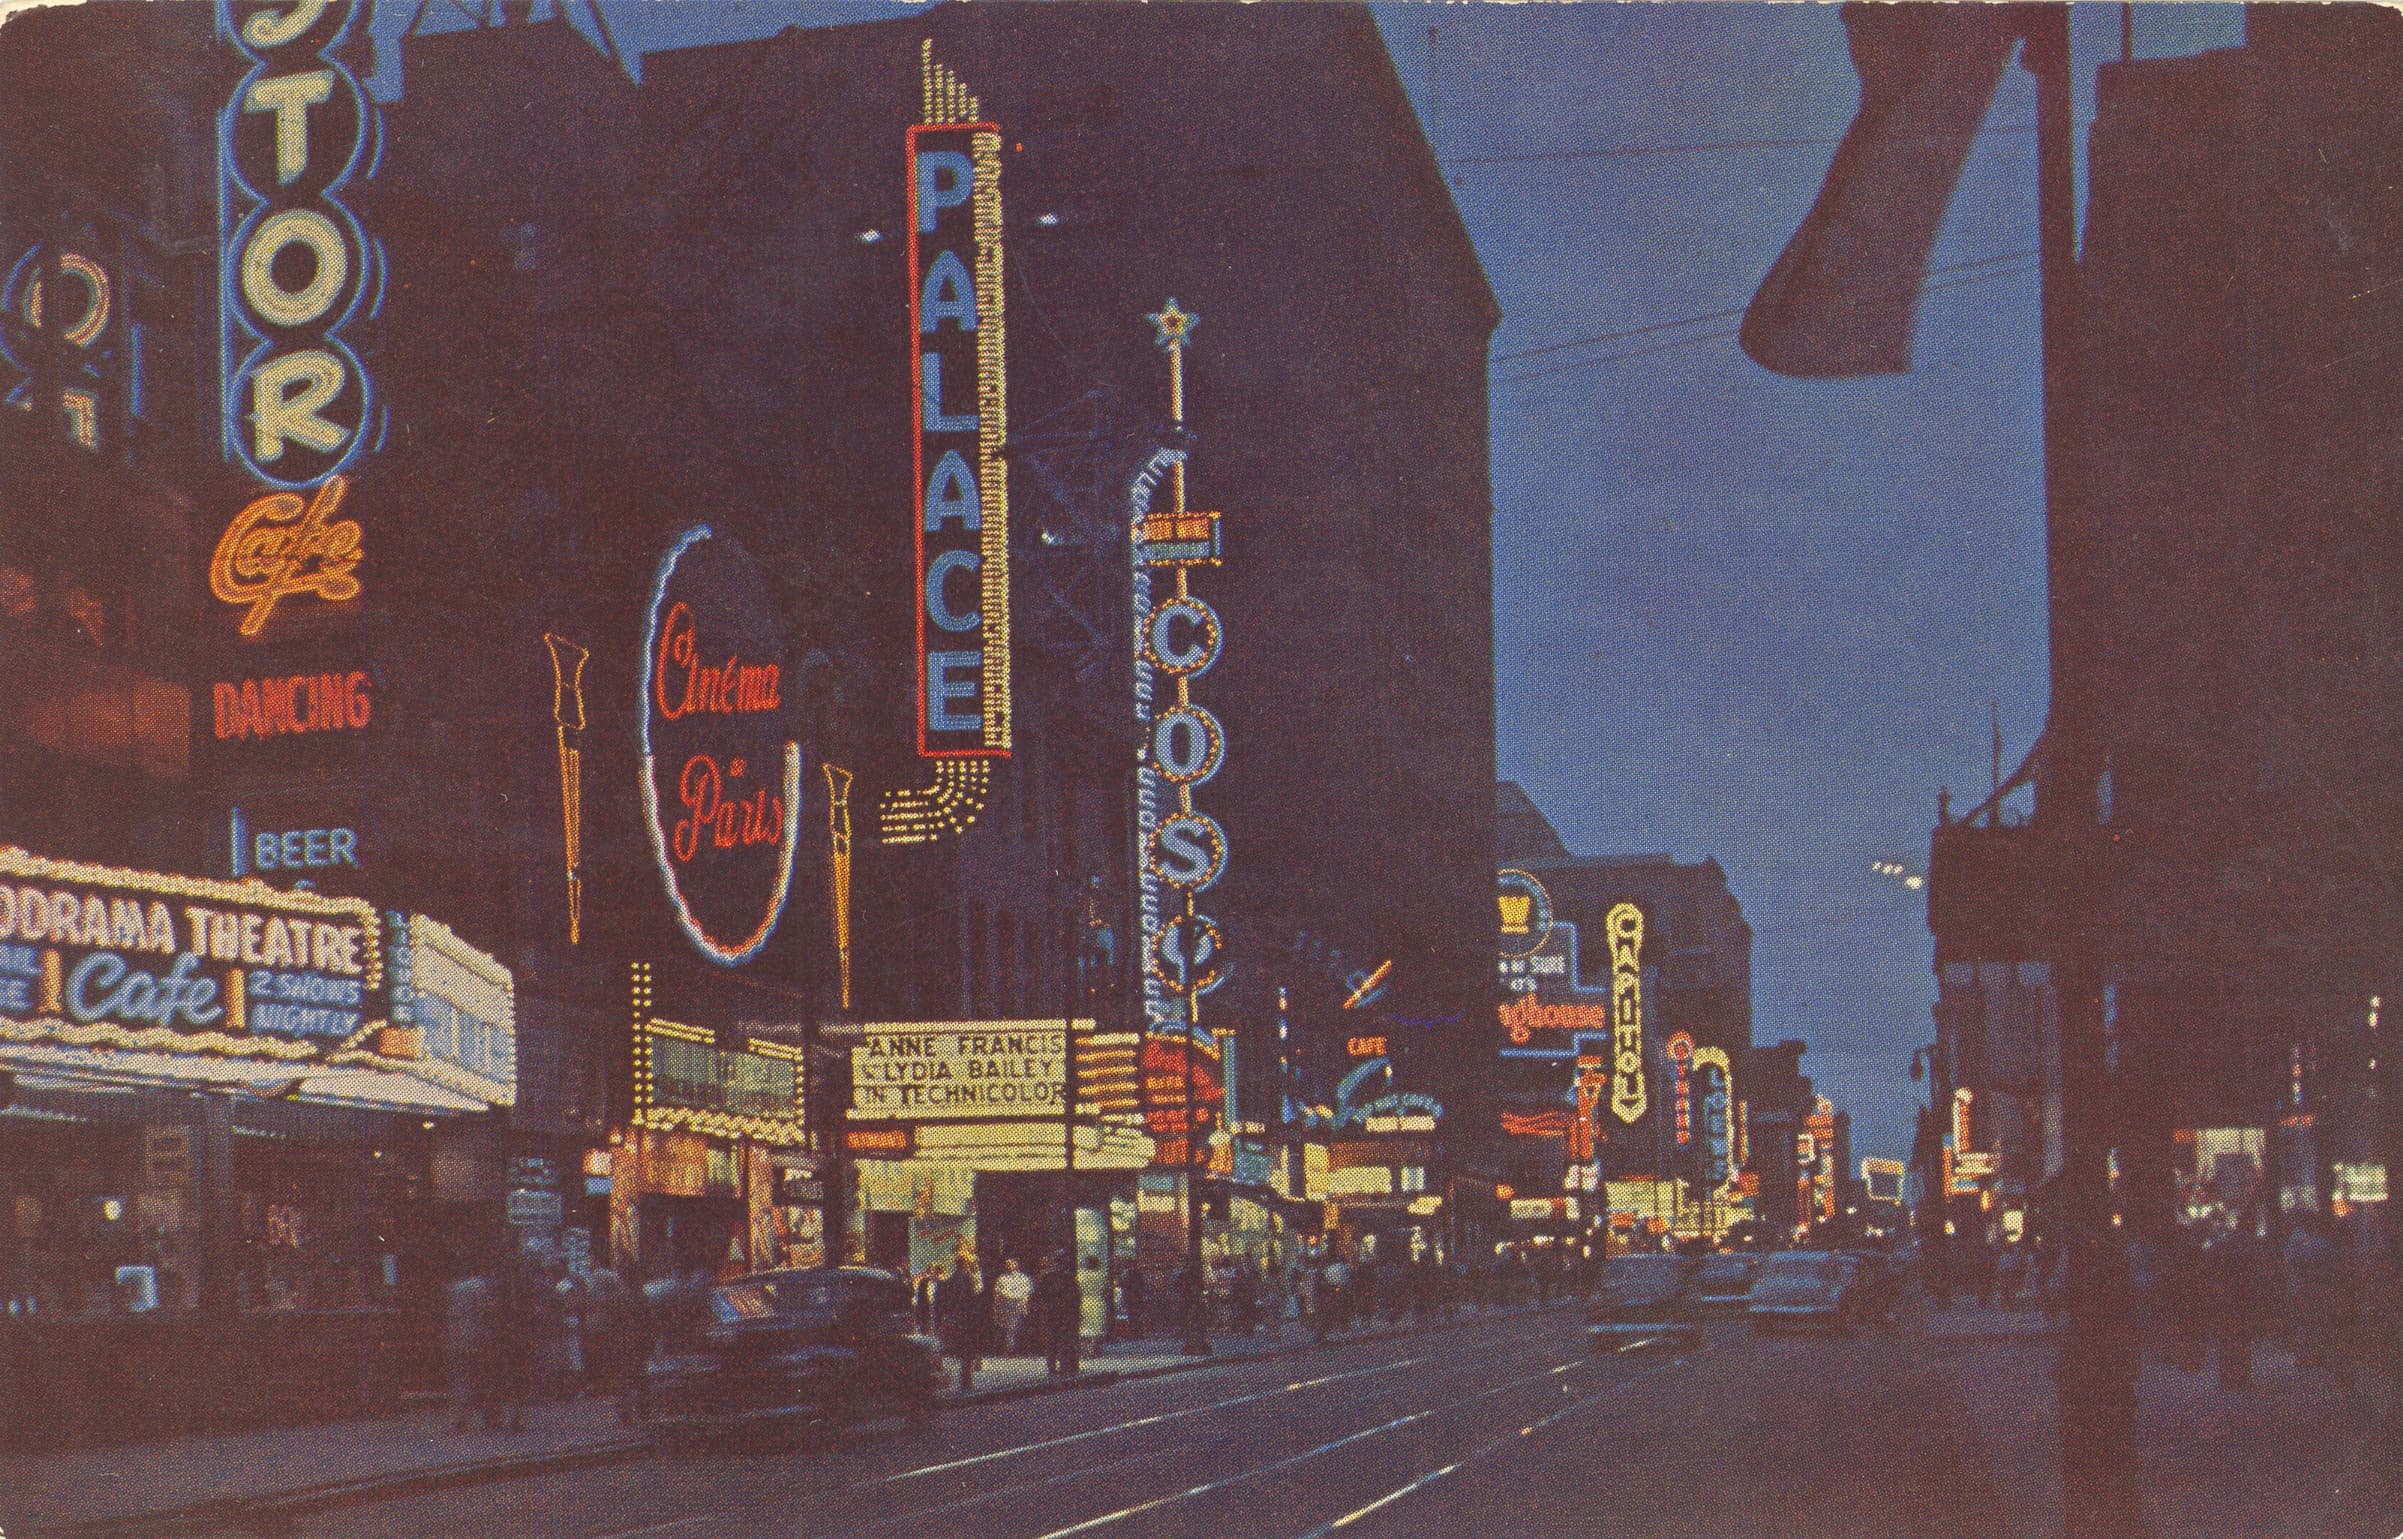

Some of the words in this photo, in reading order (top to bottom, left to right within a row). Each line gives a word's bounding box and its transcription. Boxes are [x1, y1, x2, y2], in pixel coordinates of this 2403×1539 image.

[915, 150, 983, 732] PALACE
[212, 670, 372, 741] DANCING
[255, 827, 361, 871] BEER
[184, 904, 363, 975] THEATRE
[67, 951, 223, 1027] Cafe
[250, 969, 273, 997] 2
[870, 1037, 937, 1058] ANNE
[957, 1033, 1064, 1055] FRANCIS
[884, 1060, 951, 1081] LYDIA
[967, 1058, 1051, 1080] BAILEY
[901, 1081, 1066, 1105] TECHNICOLOR
